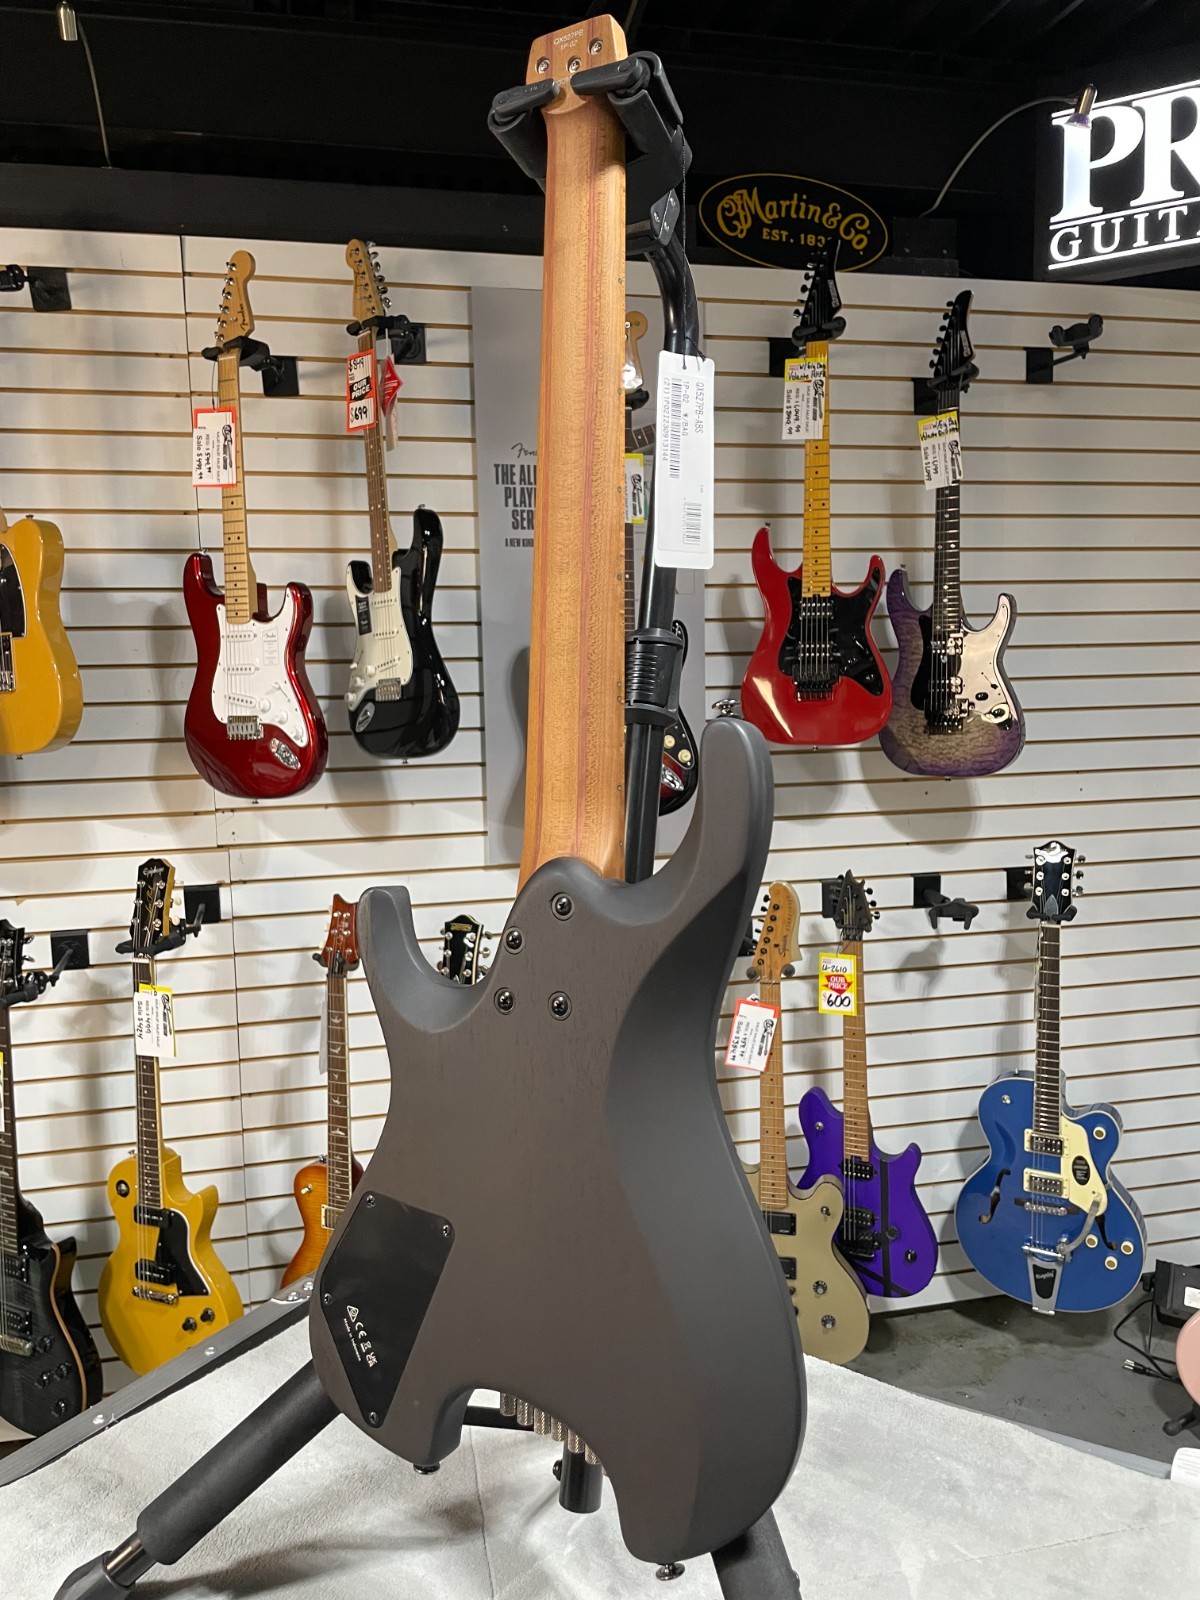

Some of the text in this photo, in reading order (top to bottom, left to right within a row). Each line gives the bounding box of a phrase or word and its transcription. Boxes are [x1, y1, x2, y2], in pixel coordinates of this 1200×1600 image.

[762, 228, 832, 248] EST. 183
[1050, 206, 1200, 262] GUIT
[352, 384, 370, 400] PRICE
[353, 379, 367, 391] OUR
[695, 382, 704, 433] QX527PB-ABS
[494, 464, 516, 485] THE
[510, 538, 521, 547] NEW
